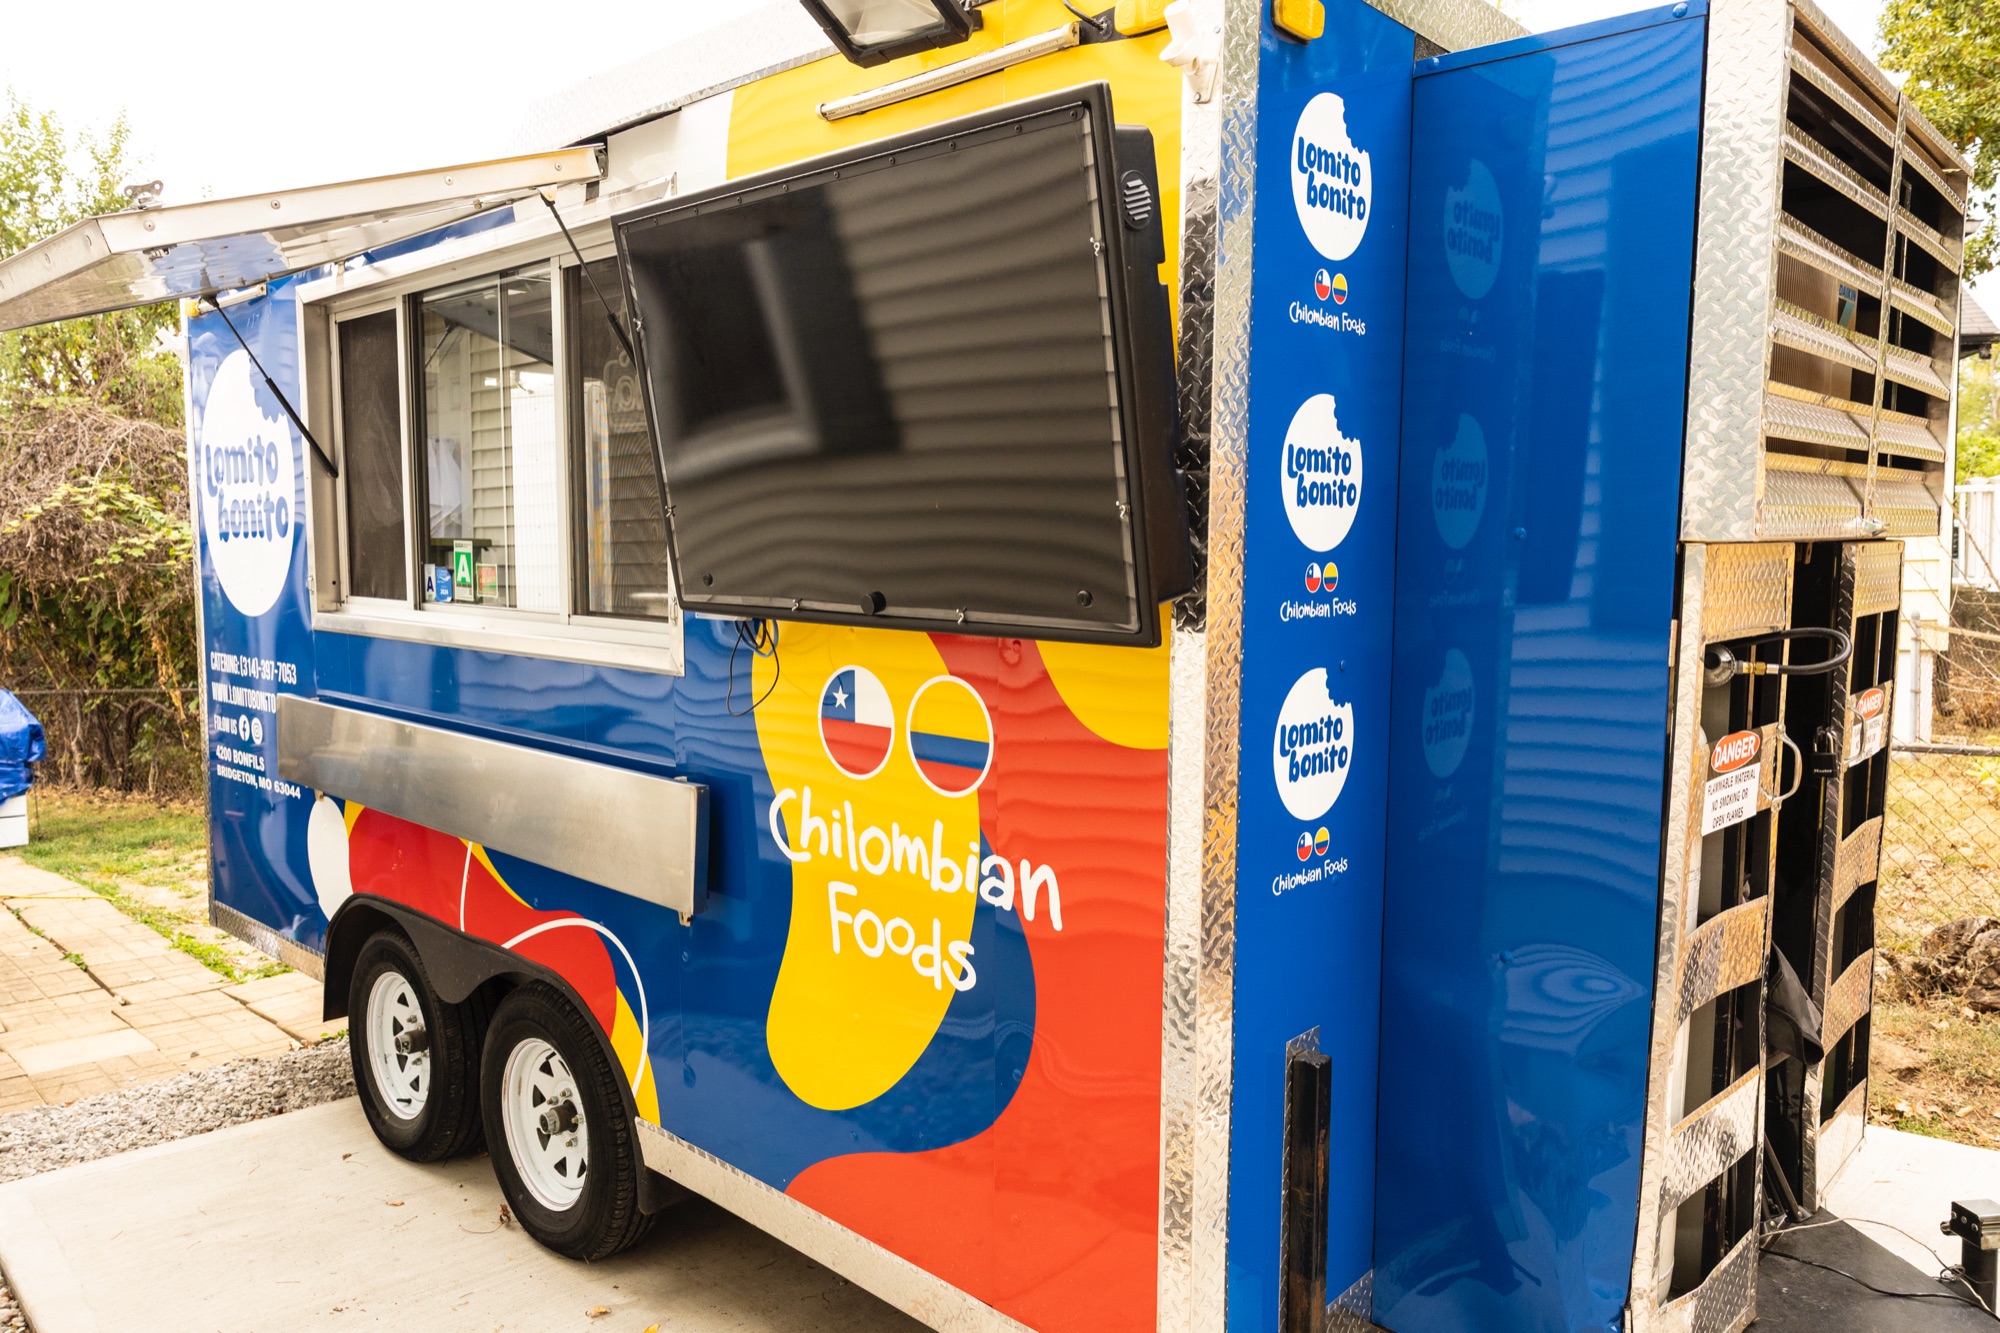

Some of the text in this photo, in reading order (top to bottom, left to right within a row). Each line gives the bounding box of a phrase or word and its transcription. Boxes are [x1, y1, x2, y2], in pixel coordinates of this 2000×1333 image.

[1298, 136, 1361, 187] Lomito
[1306, 170, 1366, 221] bonito
[1289, 301, 1366, 336] Chilombian Foods
[1287, 443, 1351, 479] Lomito
[1296, 473, 1357, 508] bonito
[218, 488, 289, 543] bonito
[426, 576, 435, 592] A
[456, 554, 471, 583] A
[1280, 597, 1357, 622] Chilombian Foods
[210, 651, 297, 685] CATERING: (314)-397-7053
[230, 719, 238, 736] US
[1279, 714, 1343, 757] Lomito
[216, 744, 265, 772] 4200 BONFILS
[1288, 745, 1348, 783] bonito
[1714, 735, 1756, 768] DANGER
[216, 764, 301, 799] BRIDGETON, MO 63044
[1708, 768, 1756, 796] FLAMMABLE MATERIAL
[1712, 788, 1749, 812] NO SMOKING OR
[1712, 806, 1744, 829] OPEN FLAMES
[769, 785, 1063, 932] Chilombian
[1272, 857, 1348, 896] Chilombian Foods
[828, 880, 977, 992] Foods
